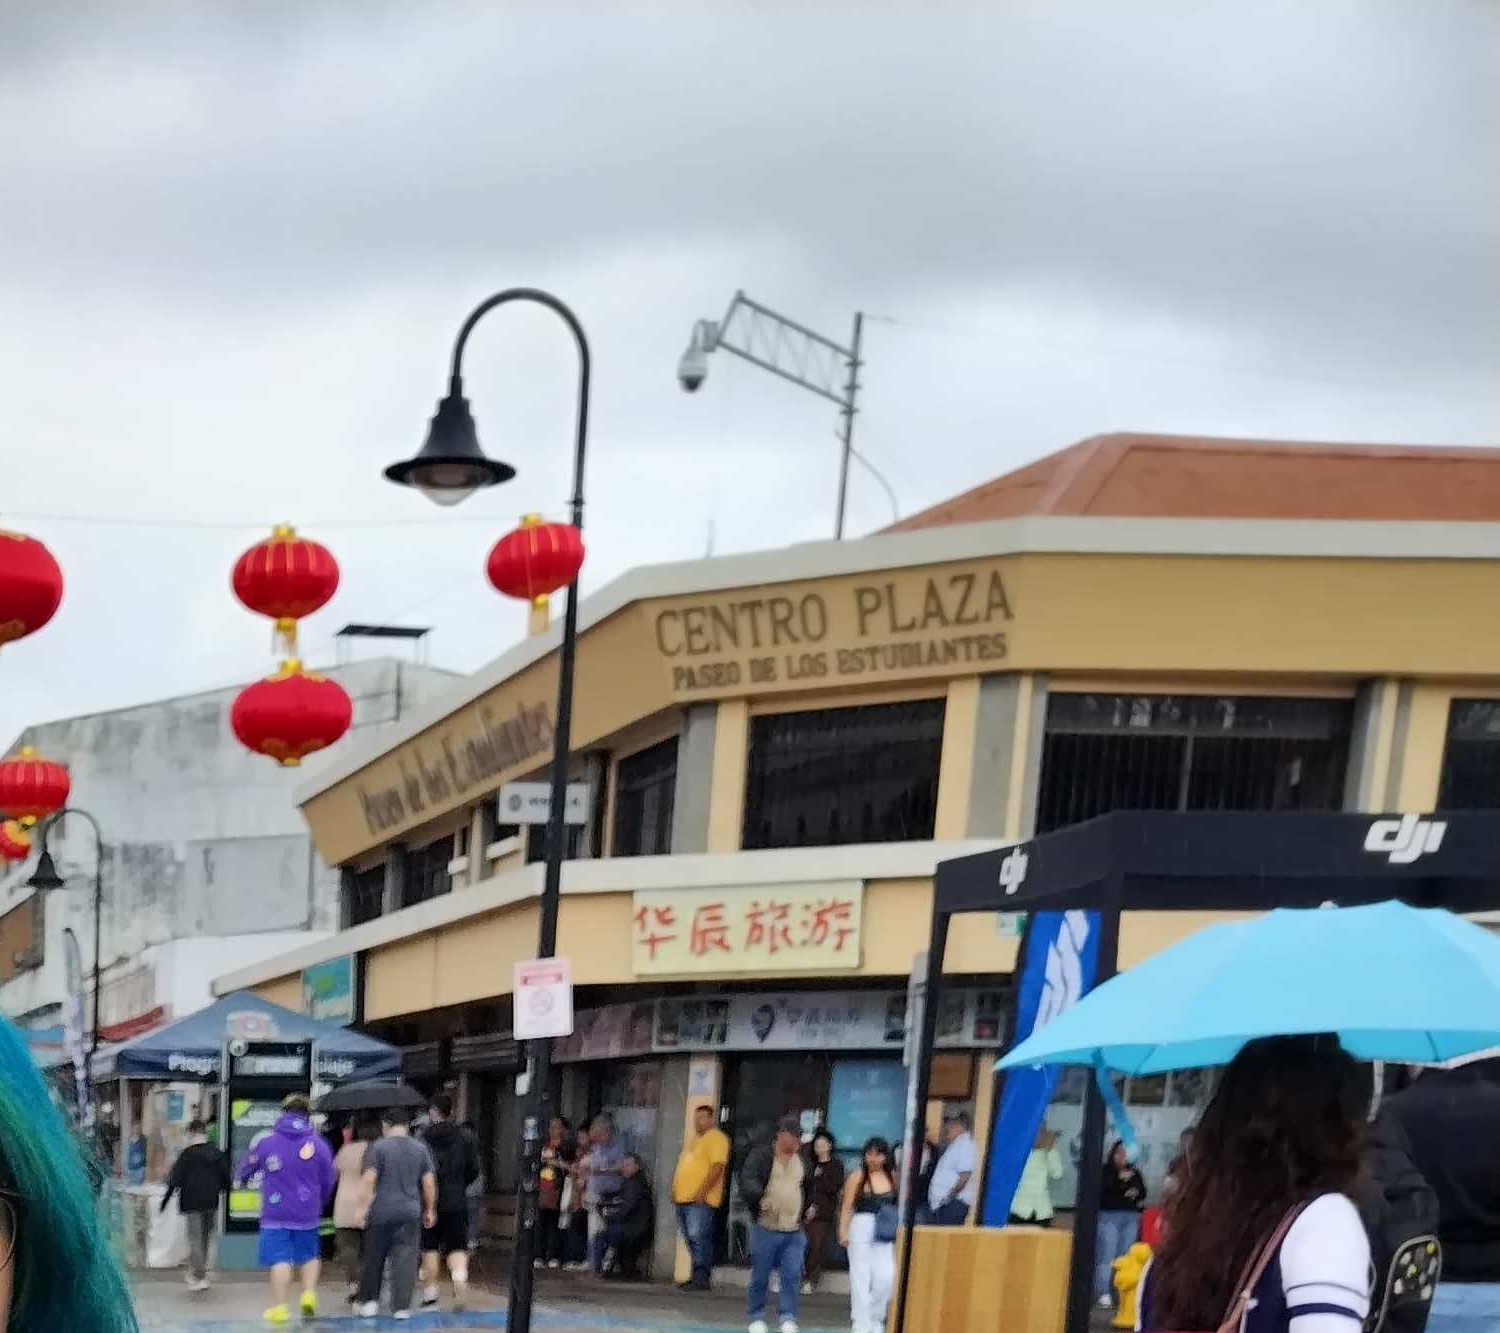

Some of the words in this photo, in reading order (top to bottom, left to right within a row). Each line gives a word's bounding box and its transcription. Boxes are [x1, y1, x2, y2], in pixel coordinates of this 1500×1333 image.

[655, 593, 828, 657] CENTRO
[854, 570, 1014, 636] PLAZA
[673, 661, 741, 691] PASEO
[749, 656, 777, 682] DE
[786, 652, 828, 680] LOS
[837, 633, 1007, 674] ESTUDIANTES
[633, 898, 854, 959] 华辰旅游
